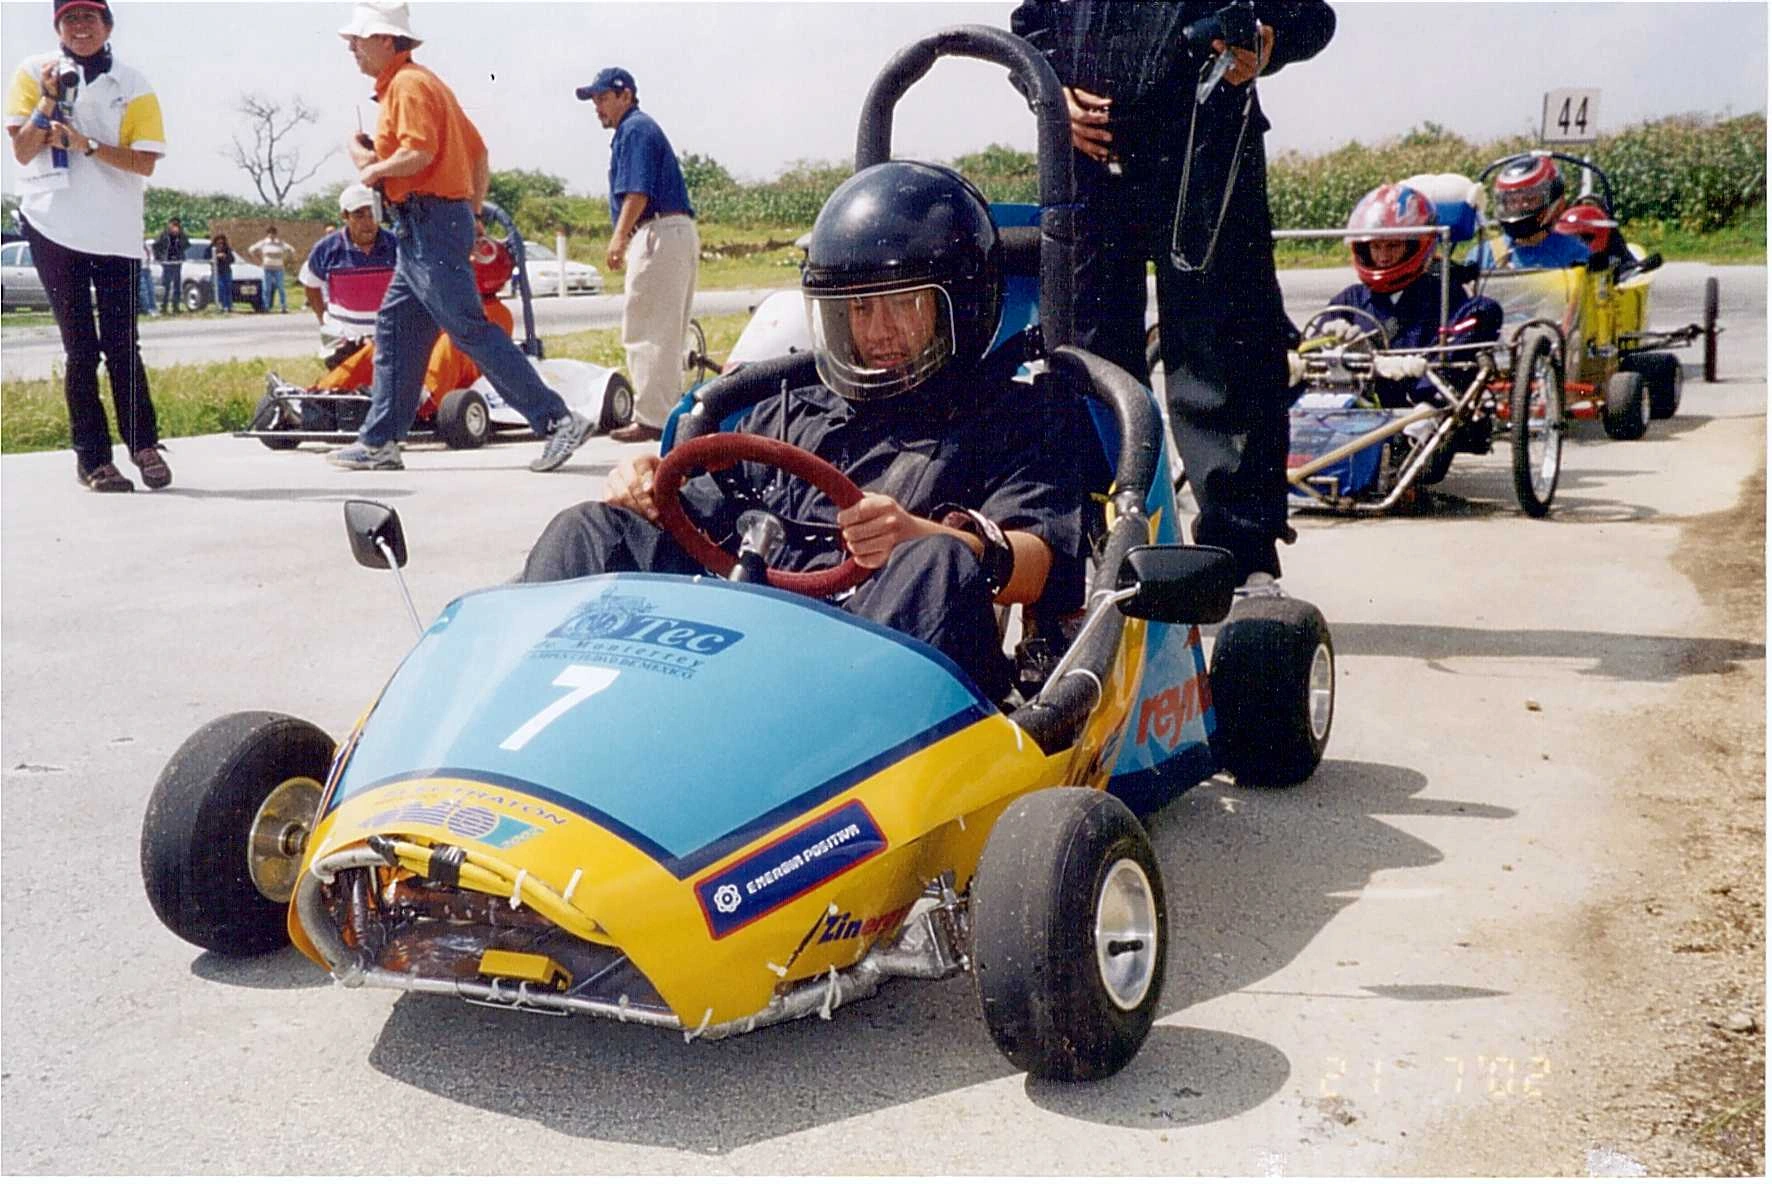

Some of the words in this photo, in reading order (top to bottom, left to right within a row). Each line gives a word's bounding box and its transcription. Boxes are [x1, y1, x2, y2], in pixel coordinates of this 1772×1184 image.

[1557, 96, 1588, 135] 44
[624, 616, 725, 652] Tec
[498, 665, 621, 751] 7
